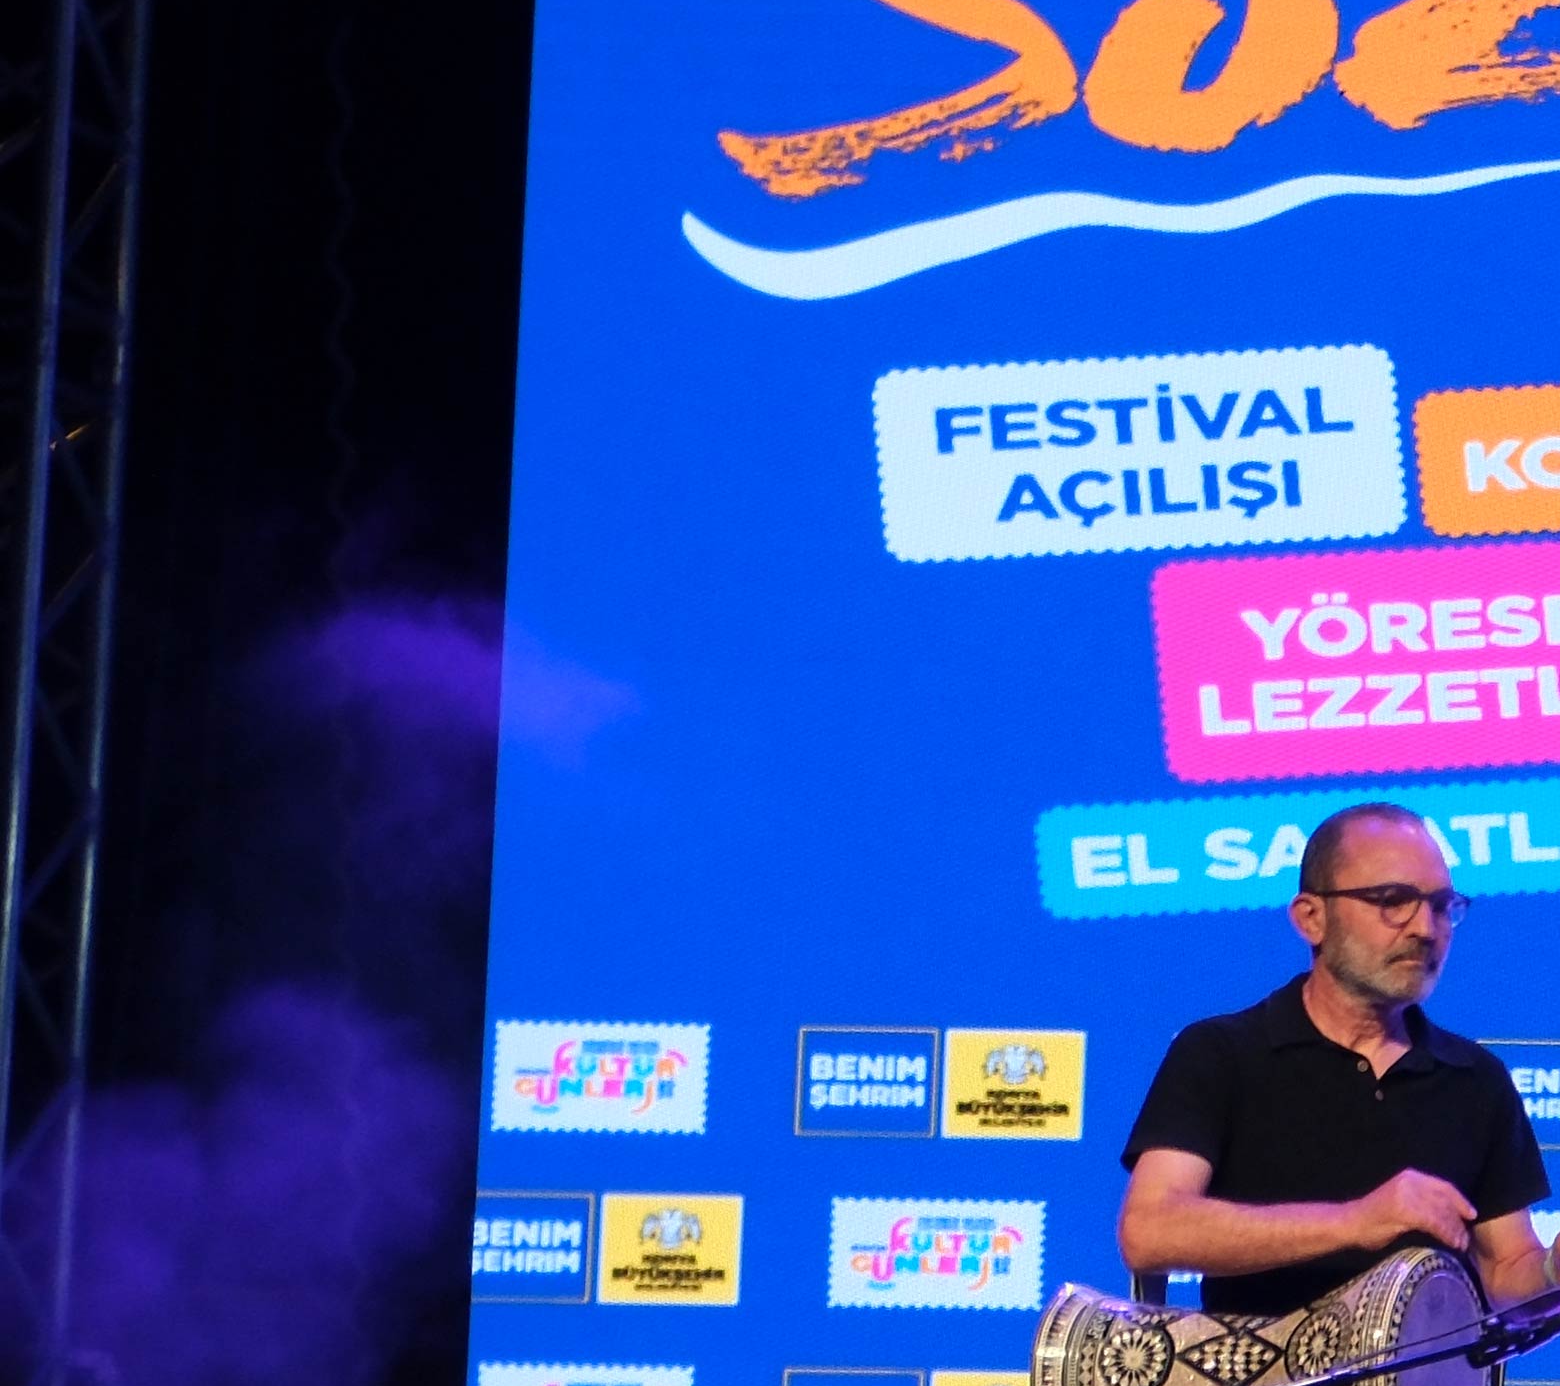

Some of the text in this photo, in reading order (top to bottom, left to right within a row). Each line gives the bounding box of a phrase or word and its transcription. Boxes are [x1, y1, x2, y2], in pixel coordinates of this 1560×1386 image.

[934, 383, 1356, 455] FESTİVAL
[996, 459, 1304, 525] AÇILIŞI
[1073, 835, 1179, 889] EL
